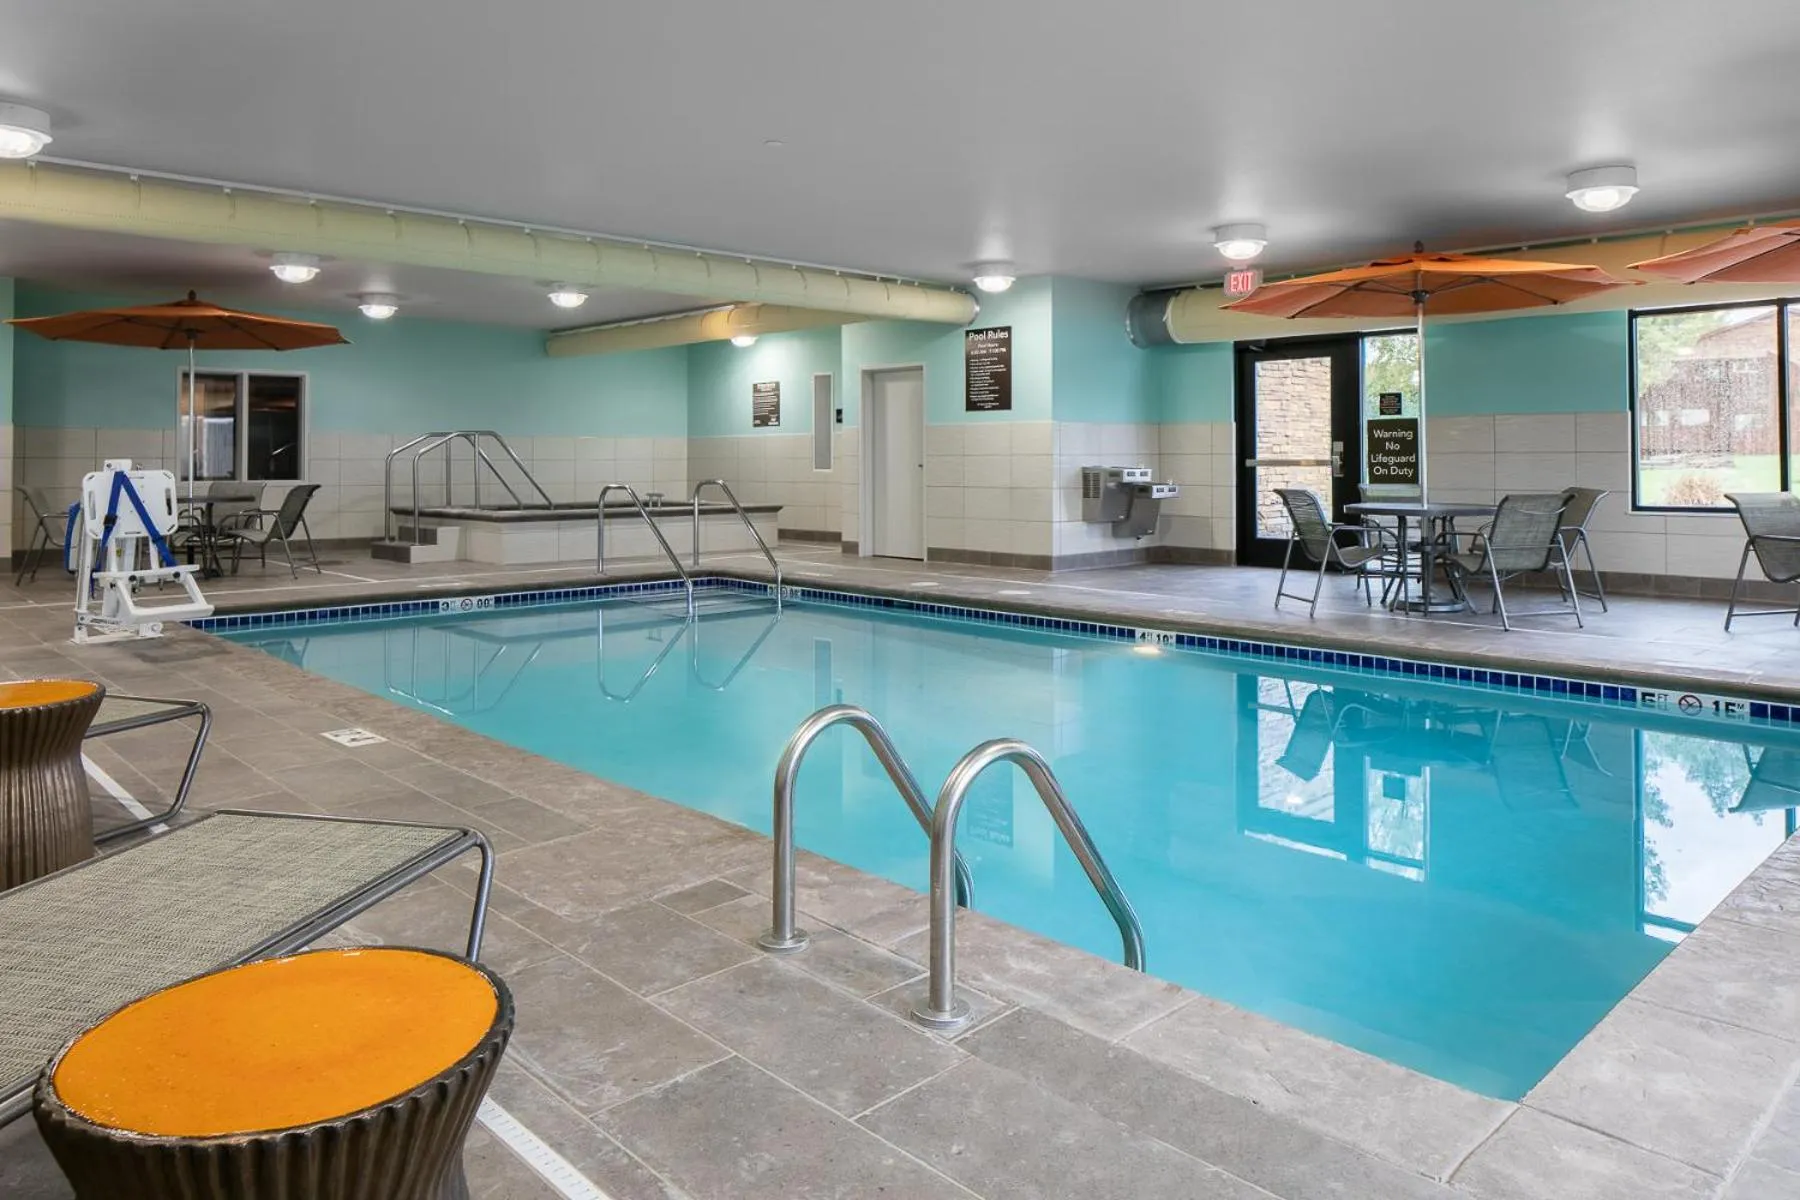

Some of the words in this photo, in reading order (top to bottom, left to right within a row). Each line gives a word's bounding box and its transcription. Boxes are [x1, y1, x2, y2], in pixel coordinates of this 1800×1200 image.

[1230, 272, 1254, 292] EXIT
[969, 331, 986, 341] Pool
[987, 329, 1009, 339] Rules
[1373, 429, 1414, 440] Warning
[1385, 441, 1401, 450] No
[1370, 453, 1416, 465] Lifeguard
[1373, 466, 1388, 475] On
[1390, 466, 1414, 478] Duty
